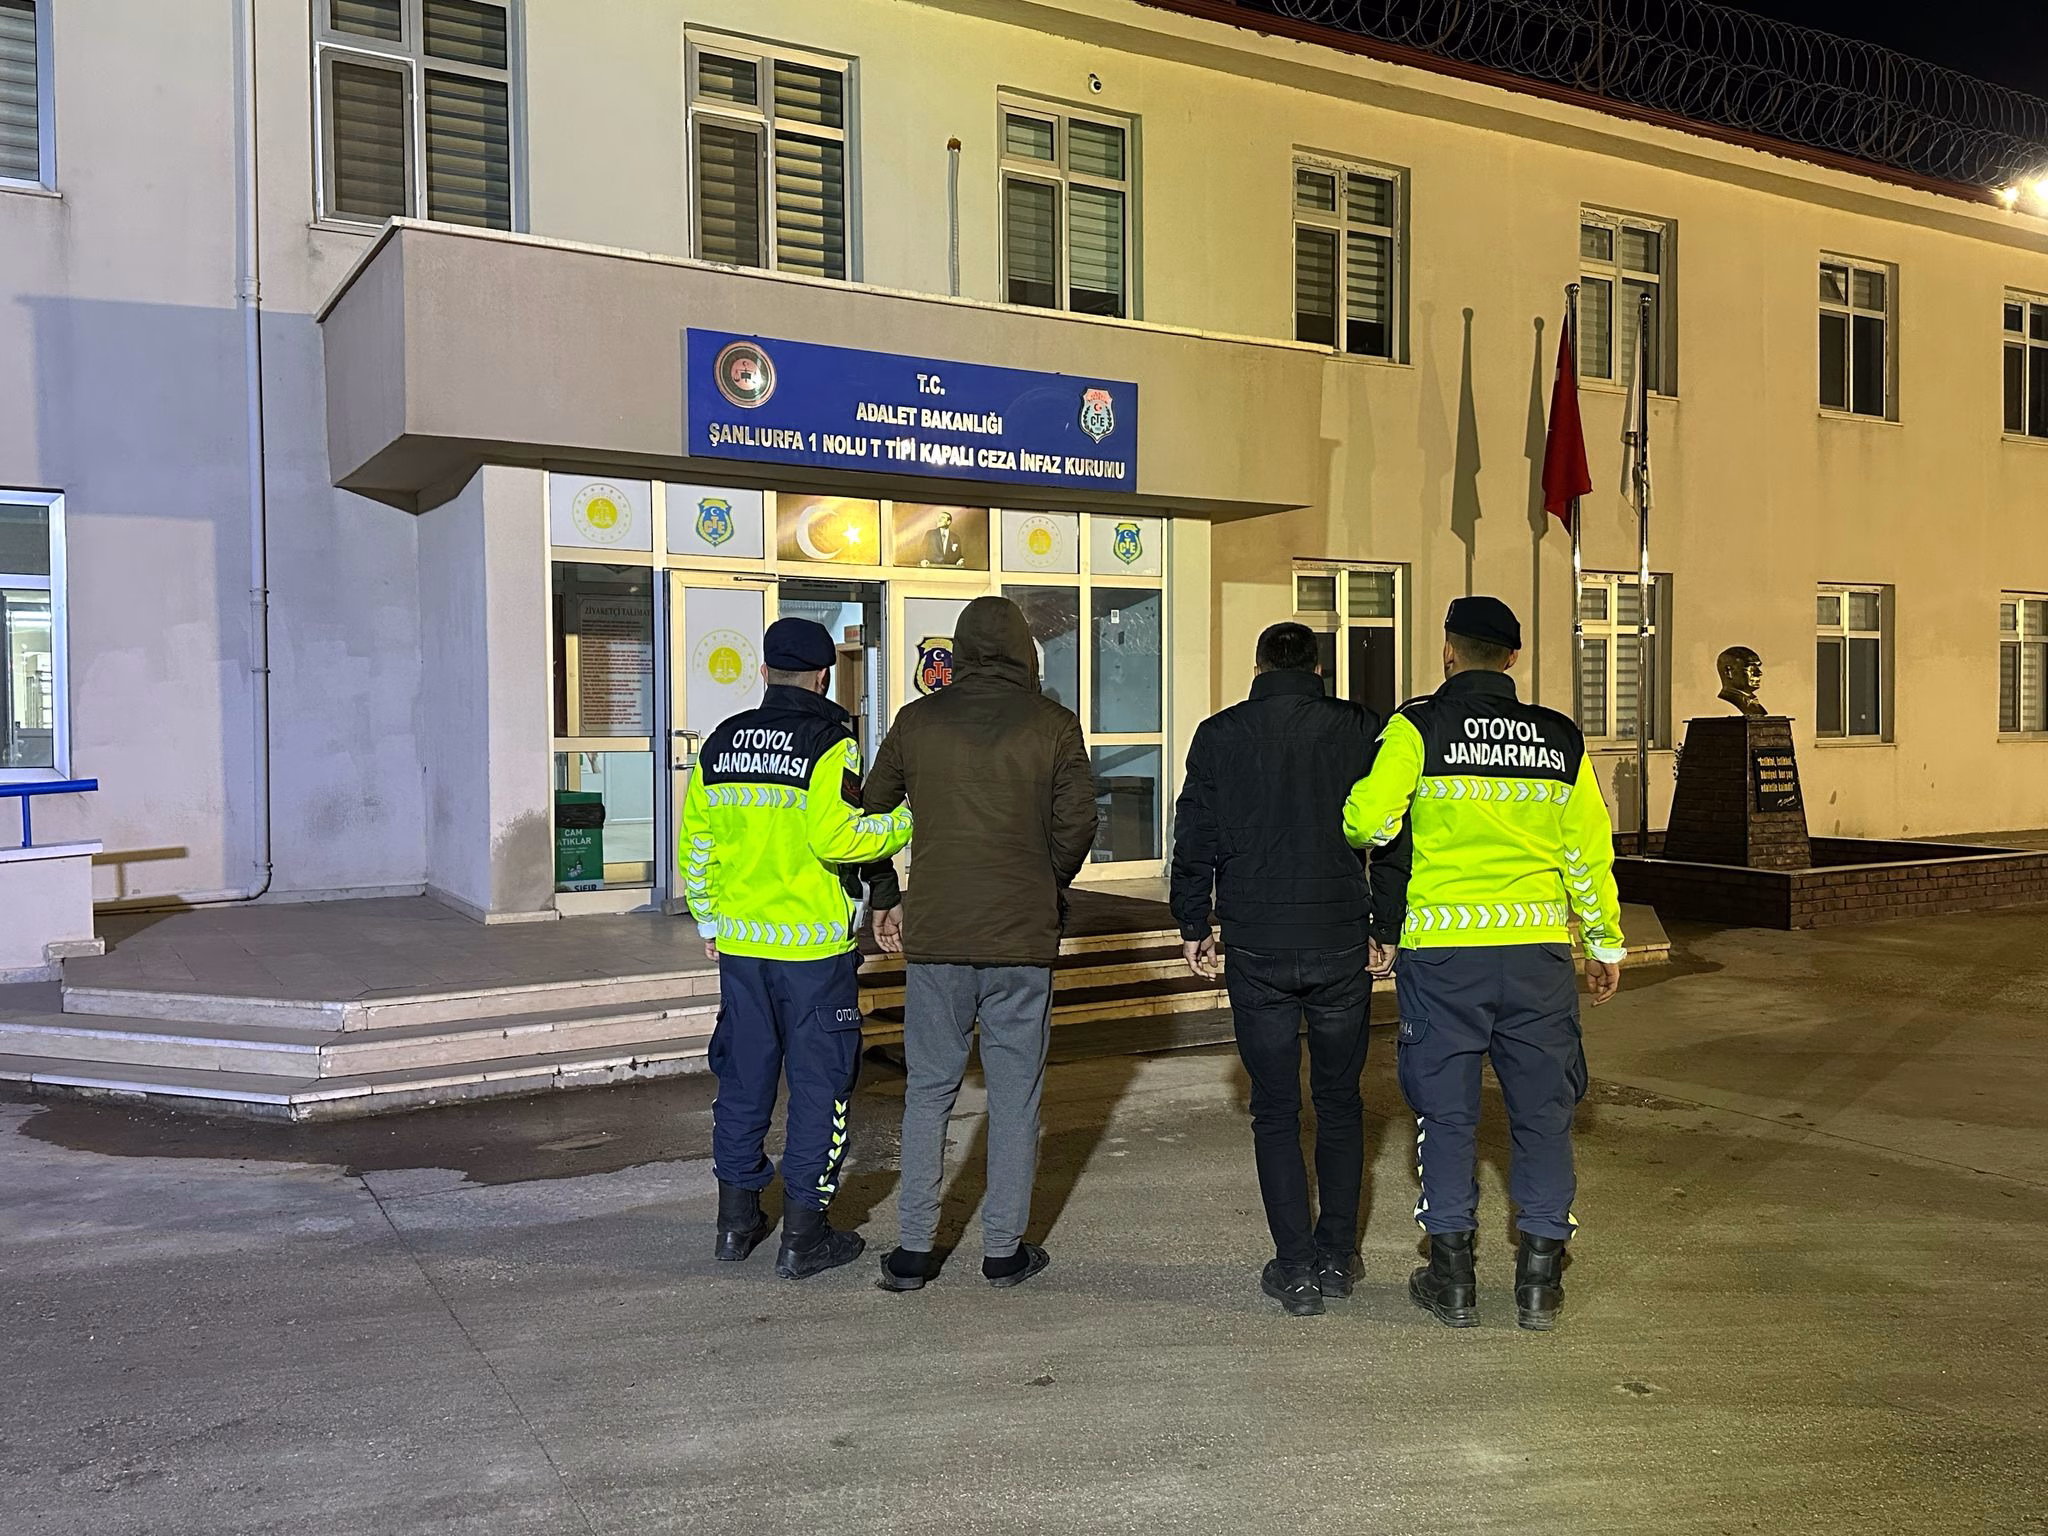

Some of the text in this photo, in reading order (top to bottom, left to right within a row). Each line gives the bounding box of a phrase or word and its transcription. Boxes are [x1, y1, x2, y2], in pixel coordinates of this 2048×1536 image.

[917, 373, 946, 395] T.C.
[856, 401, 1003, 435] ADALET BAKANLIĞI
[1090, 413, 1105, 427] CTE
[709, 422, 1125, 479] ŞANLIURFA 1 NOLU T TİPİ KAPALI CEZA İNFAZ KURUMU
[732, 728, 794, 752] OTOYOL
[1463, 717, 1545, 743] OTOYOL
[712, 752, 809, 779] JANDARMASI
[1443, 742, 1566, 773] JANDARMASI
[564, 829, 583, 837] CAM
